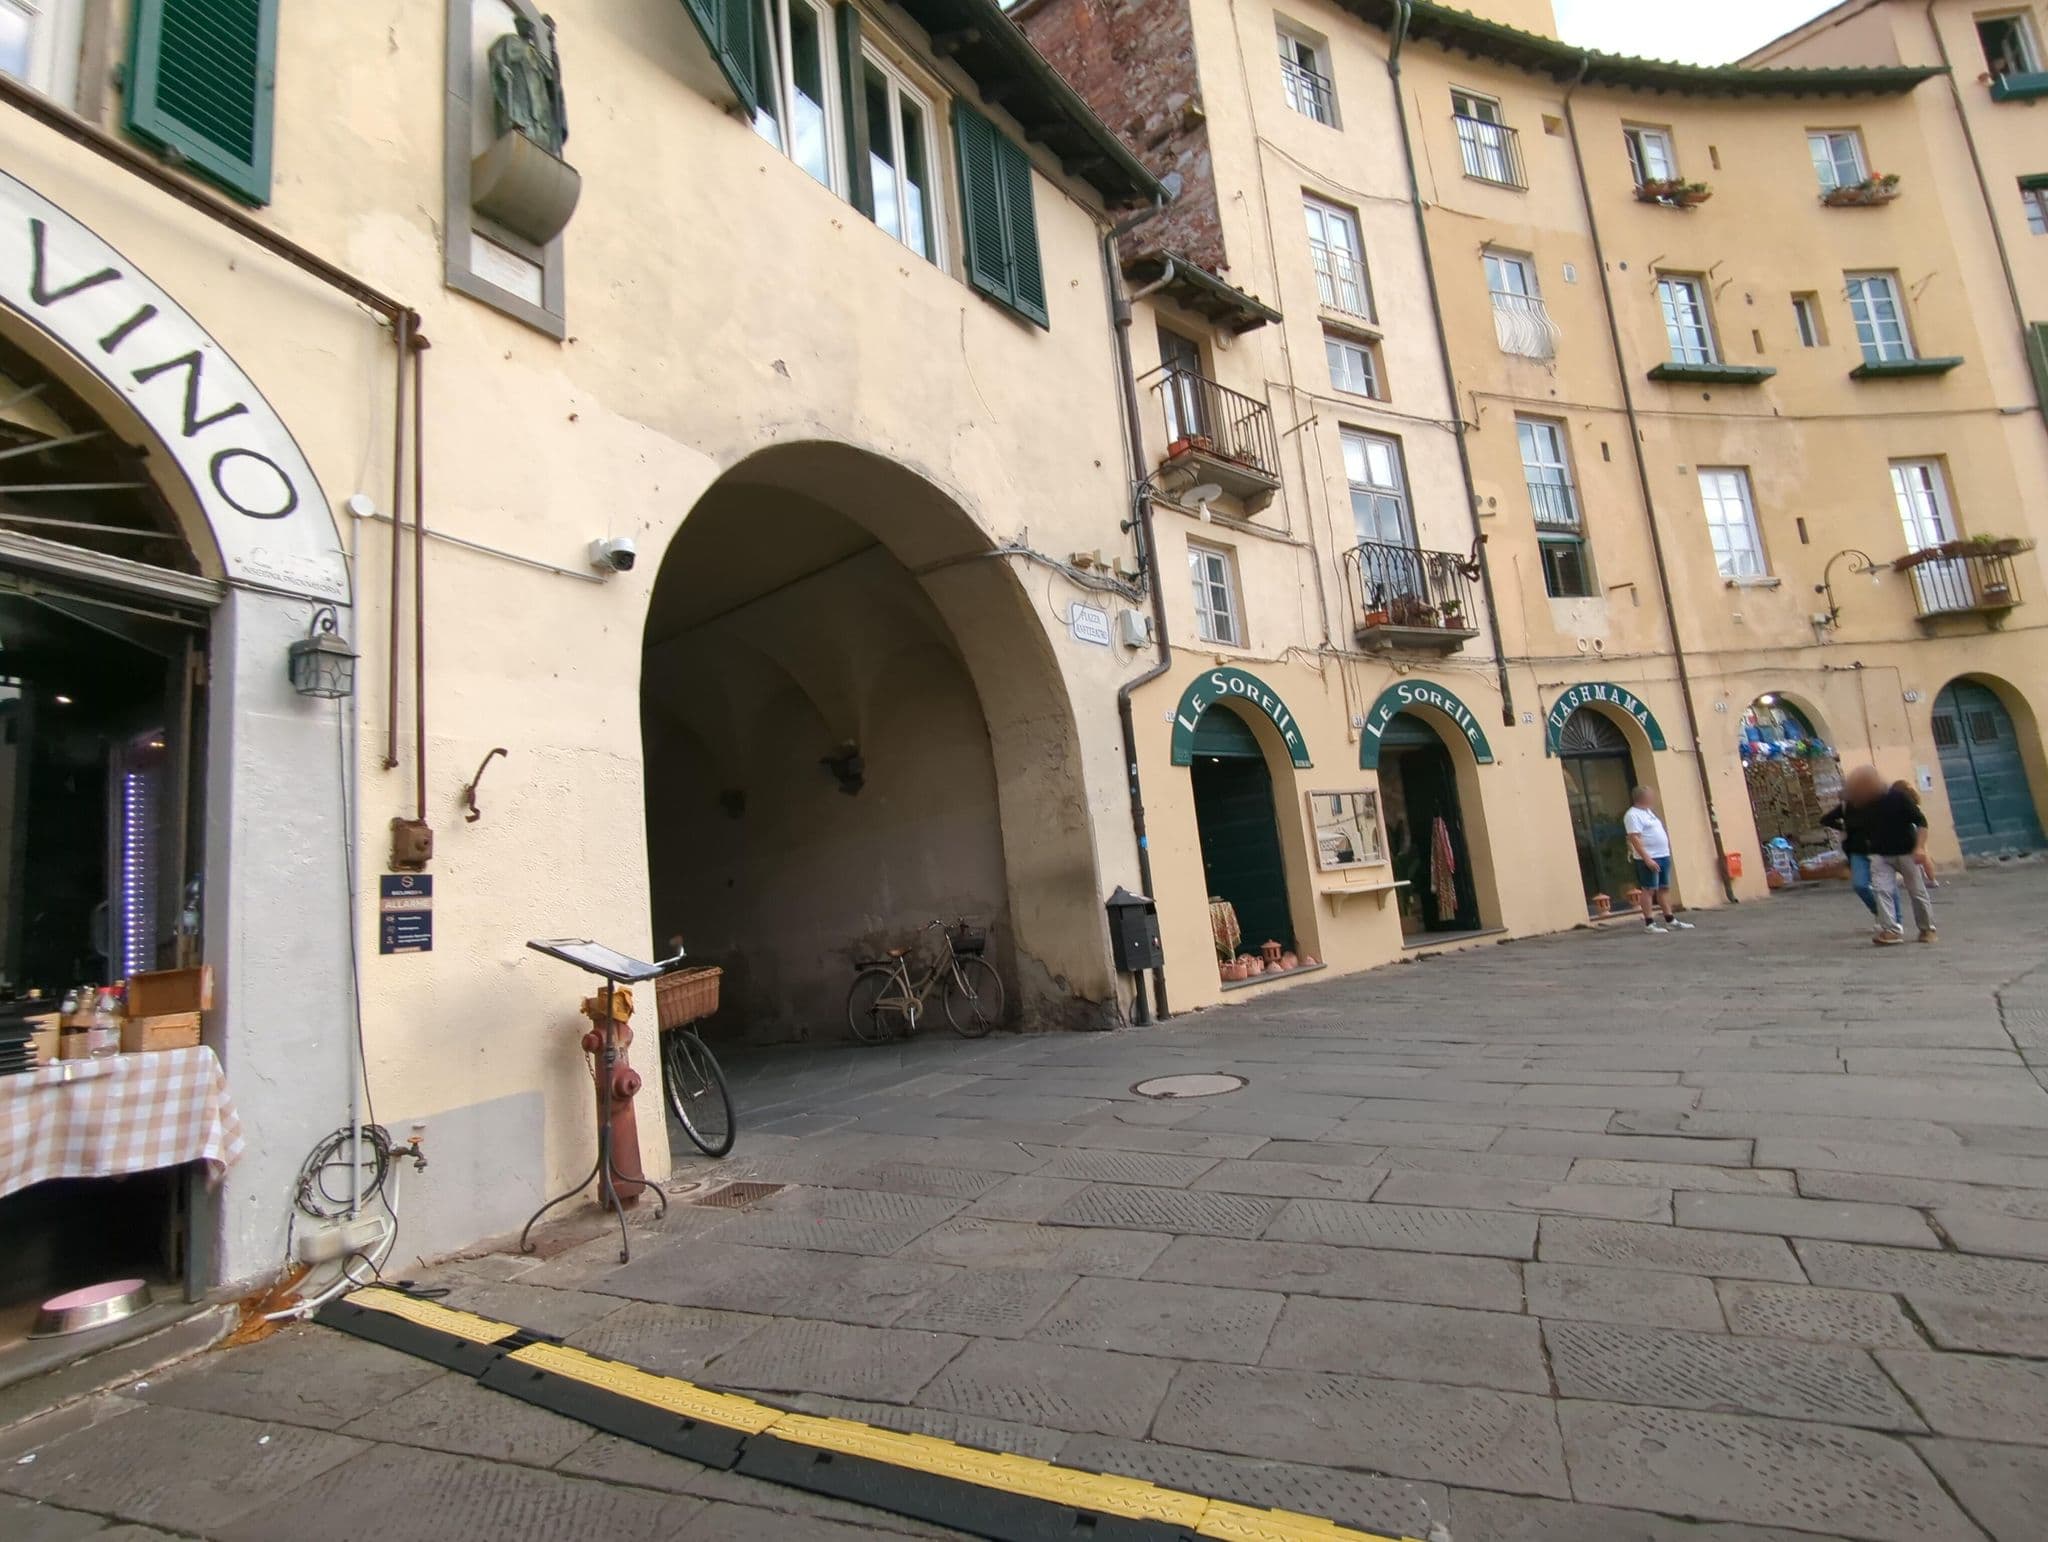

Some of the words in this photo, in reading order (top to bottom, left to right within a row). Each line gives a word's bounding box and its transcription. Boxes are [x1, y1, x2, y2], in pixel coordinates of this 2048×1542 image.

[28, 218, 299, 519] VINO
[1178, 693, 1206, 733] LE
[1211, 672, 1297, 750] SORELLE
[1366, 704, 1393, 738] LE
[1397, 684, 1479, 745] SORELLE
[1550, 684, 1649, 728] UASHMAMA
